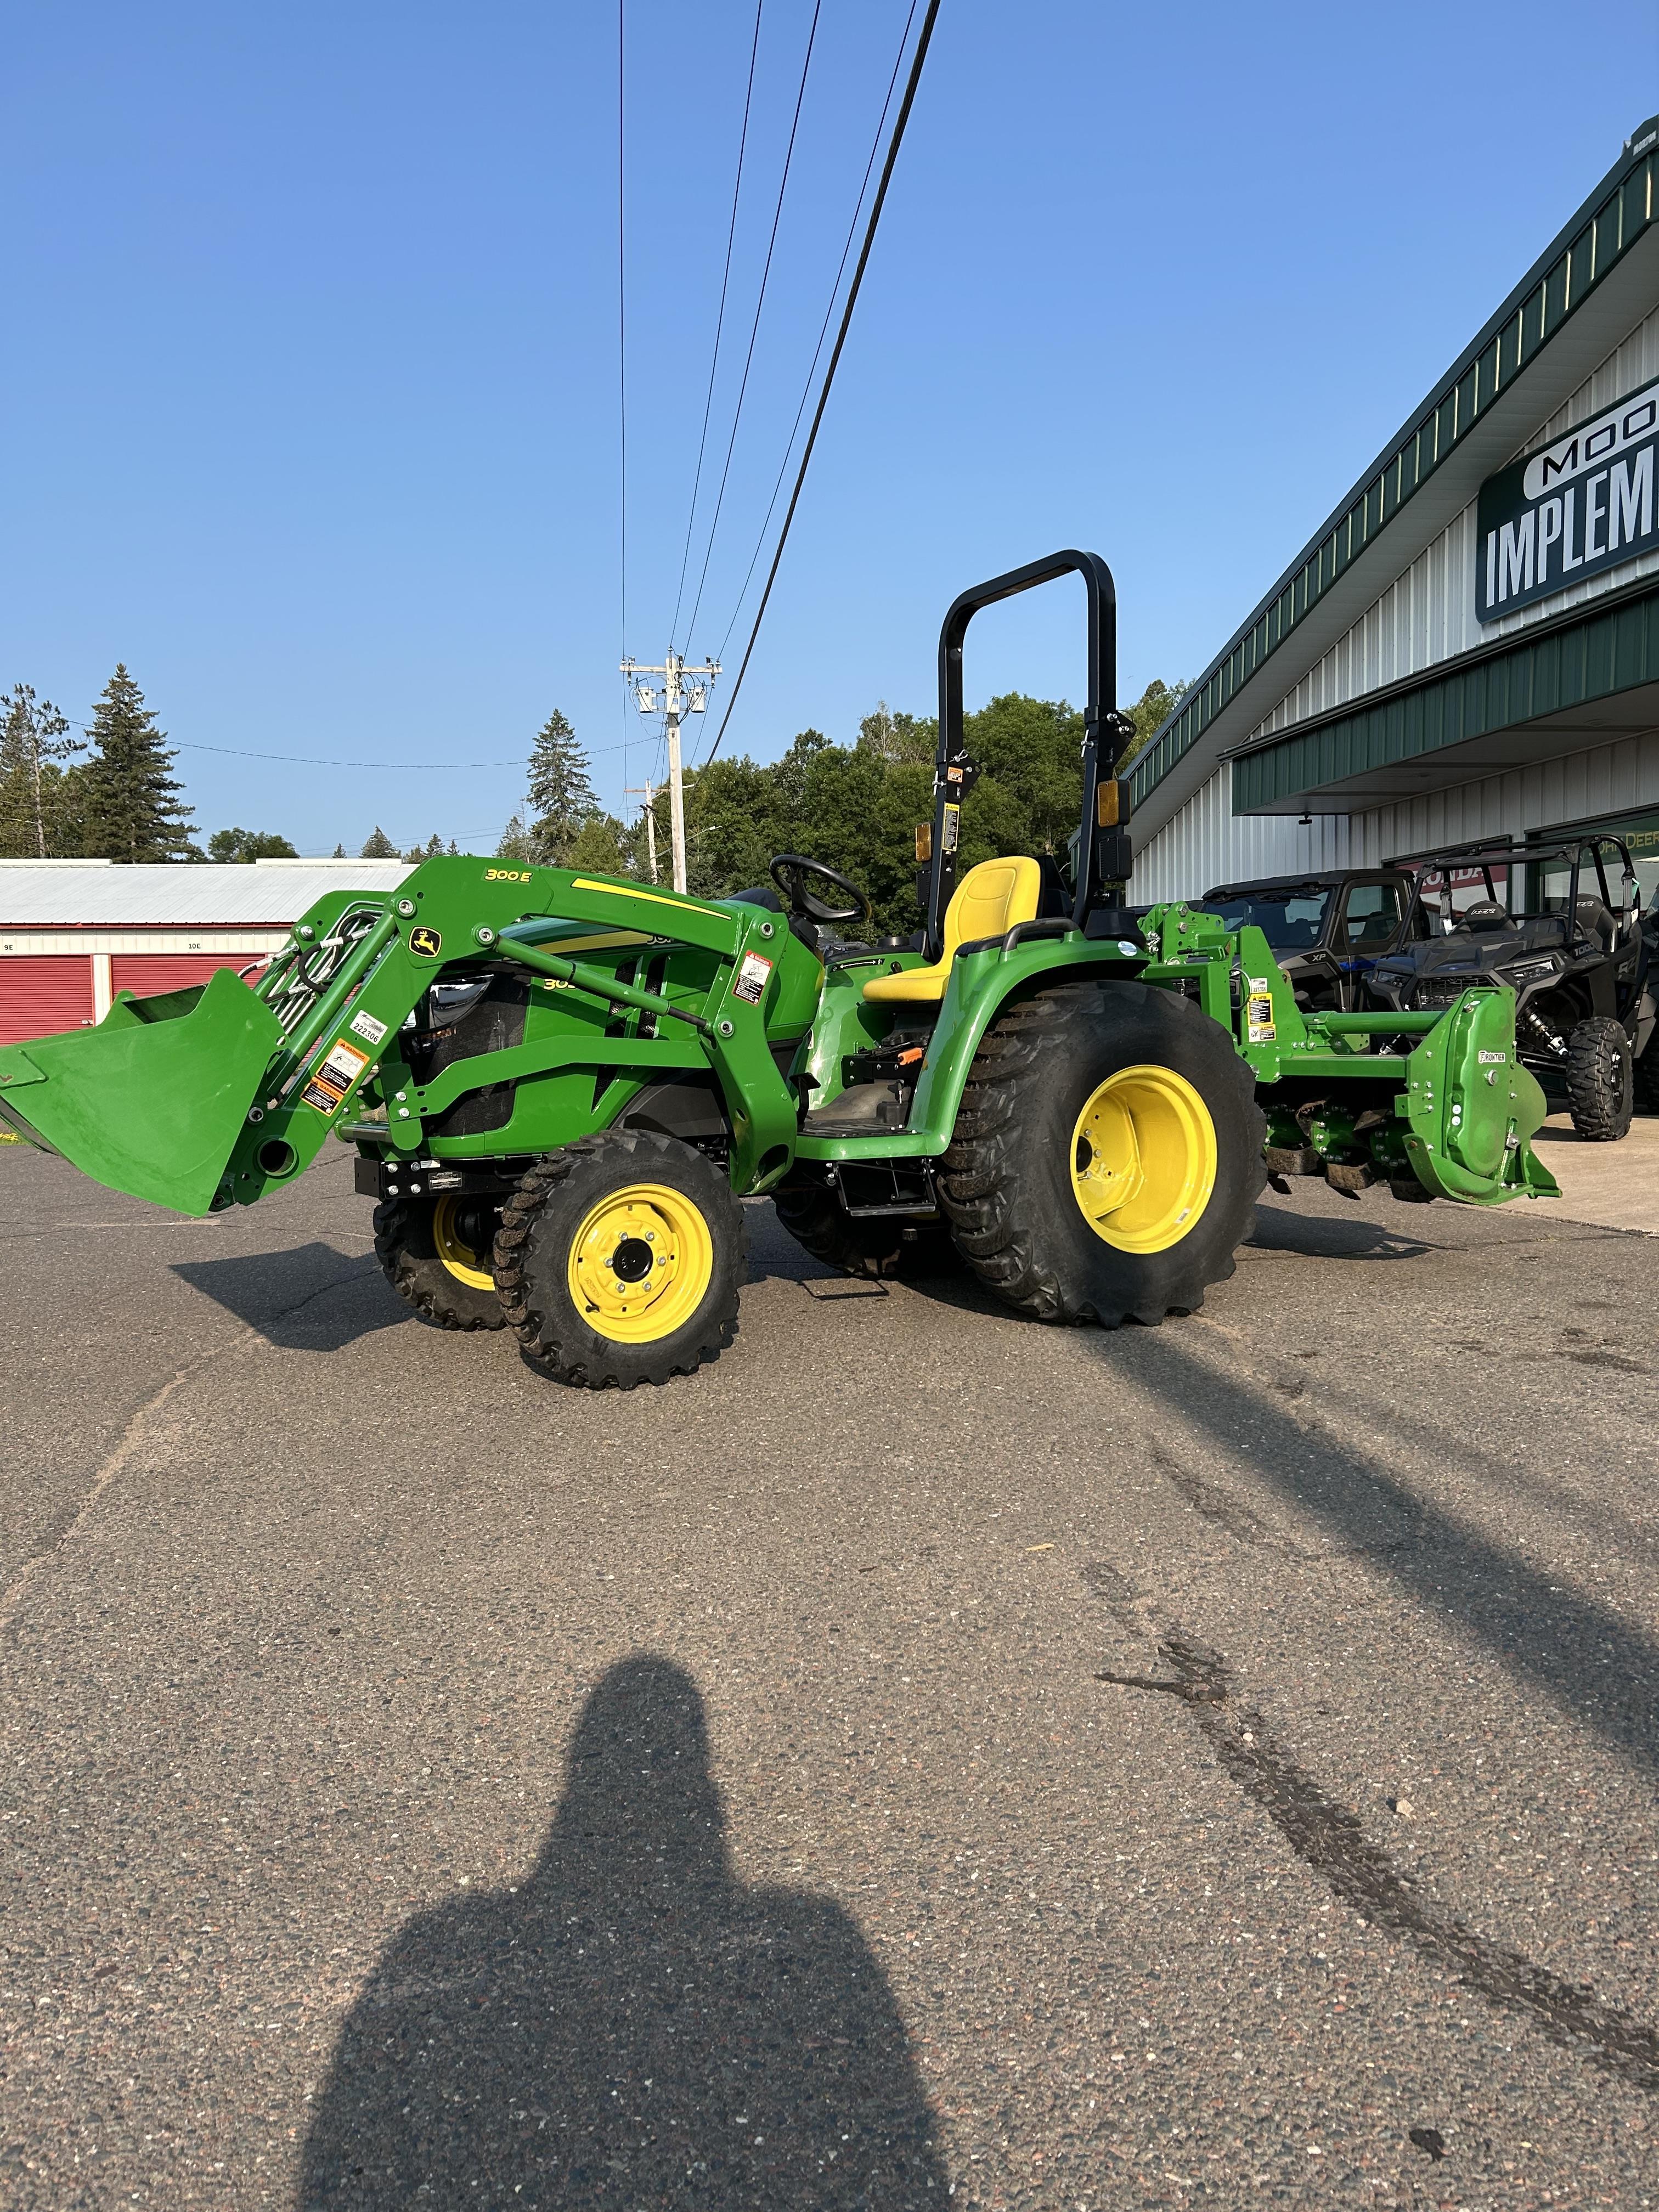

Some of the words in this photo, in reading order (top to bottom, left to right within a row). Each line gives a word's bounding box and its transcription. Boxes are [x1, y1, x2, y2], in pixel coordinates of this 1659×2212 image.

[1486, 444, 1659, 608] IMPLEM
[1312, 953, 1327, 962] XP
[353, 1023, 379, 1042] 222306
[346, 1045, 365, 1060] WARNING
[320, 1084, 339, 1099] WARNING
